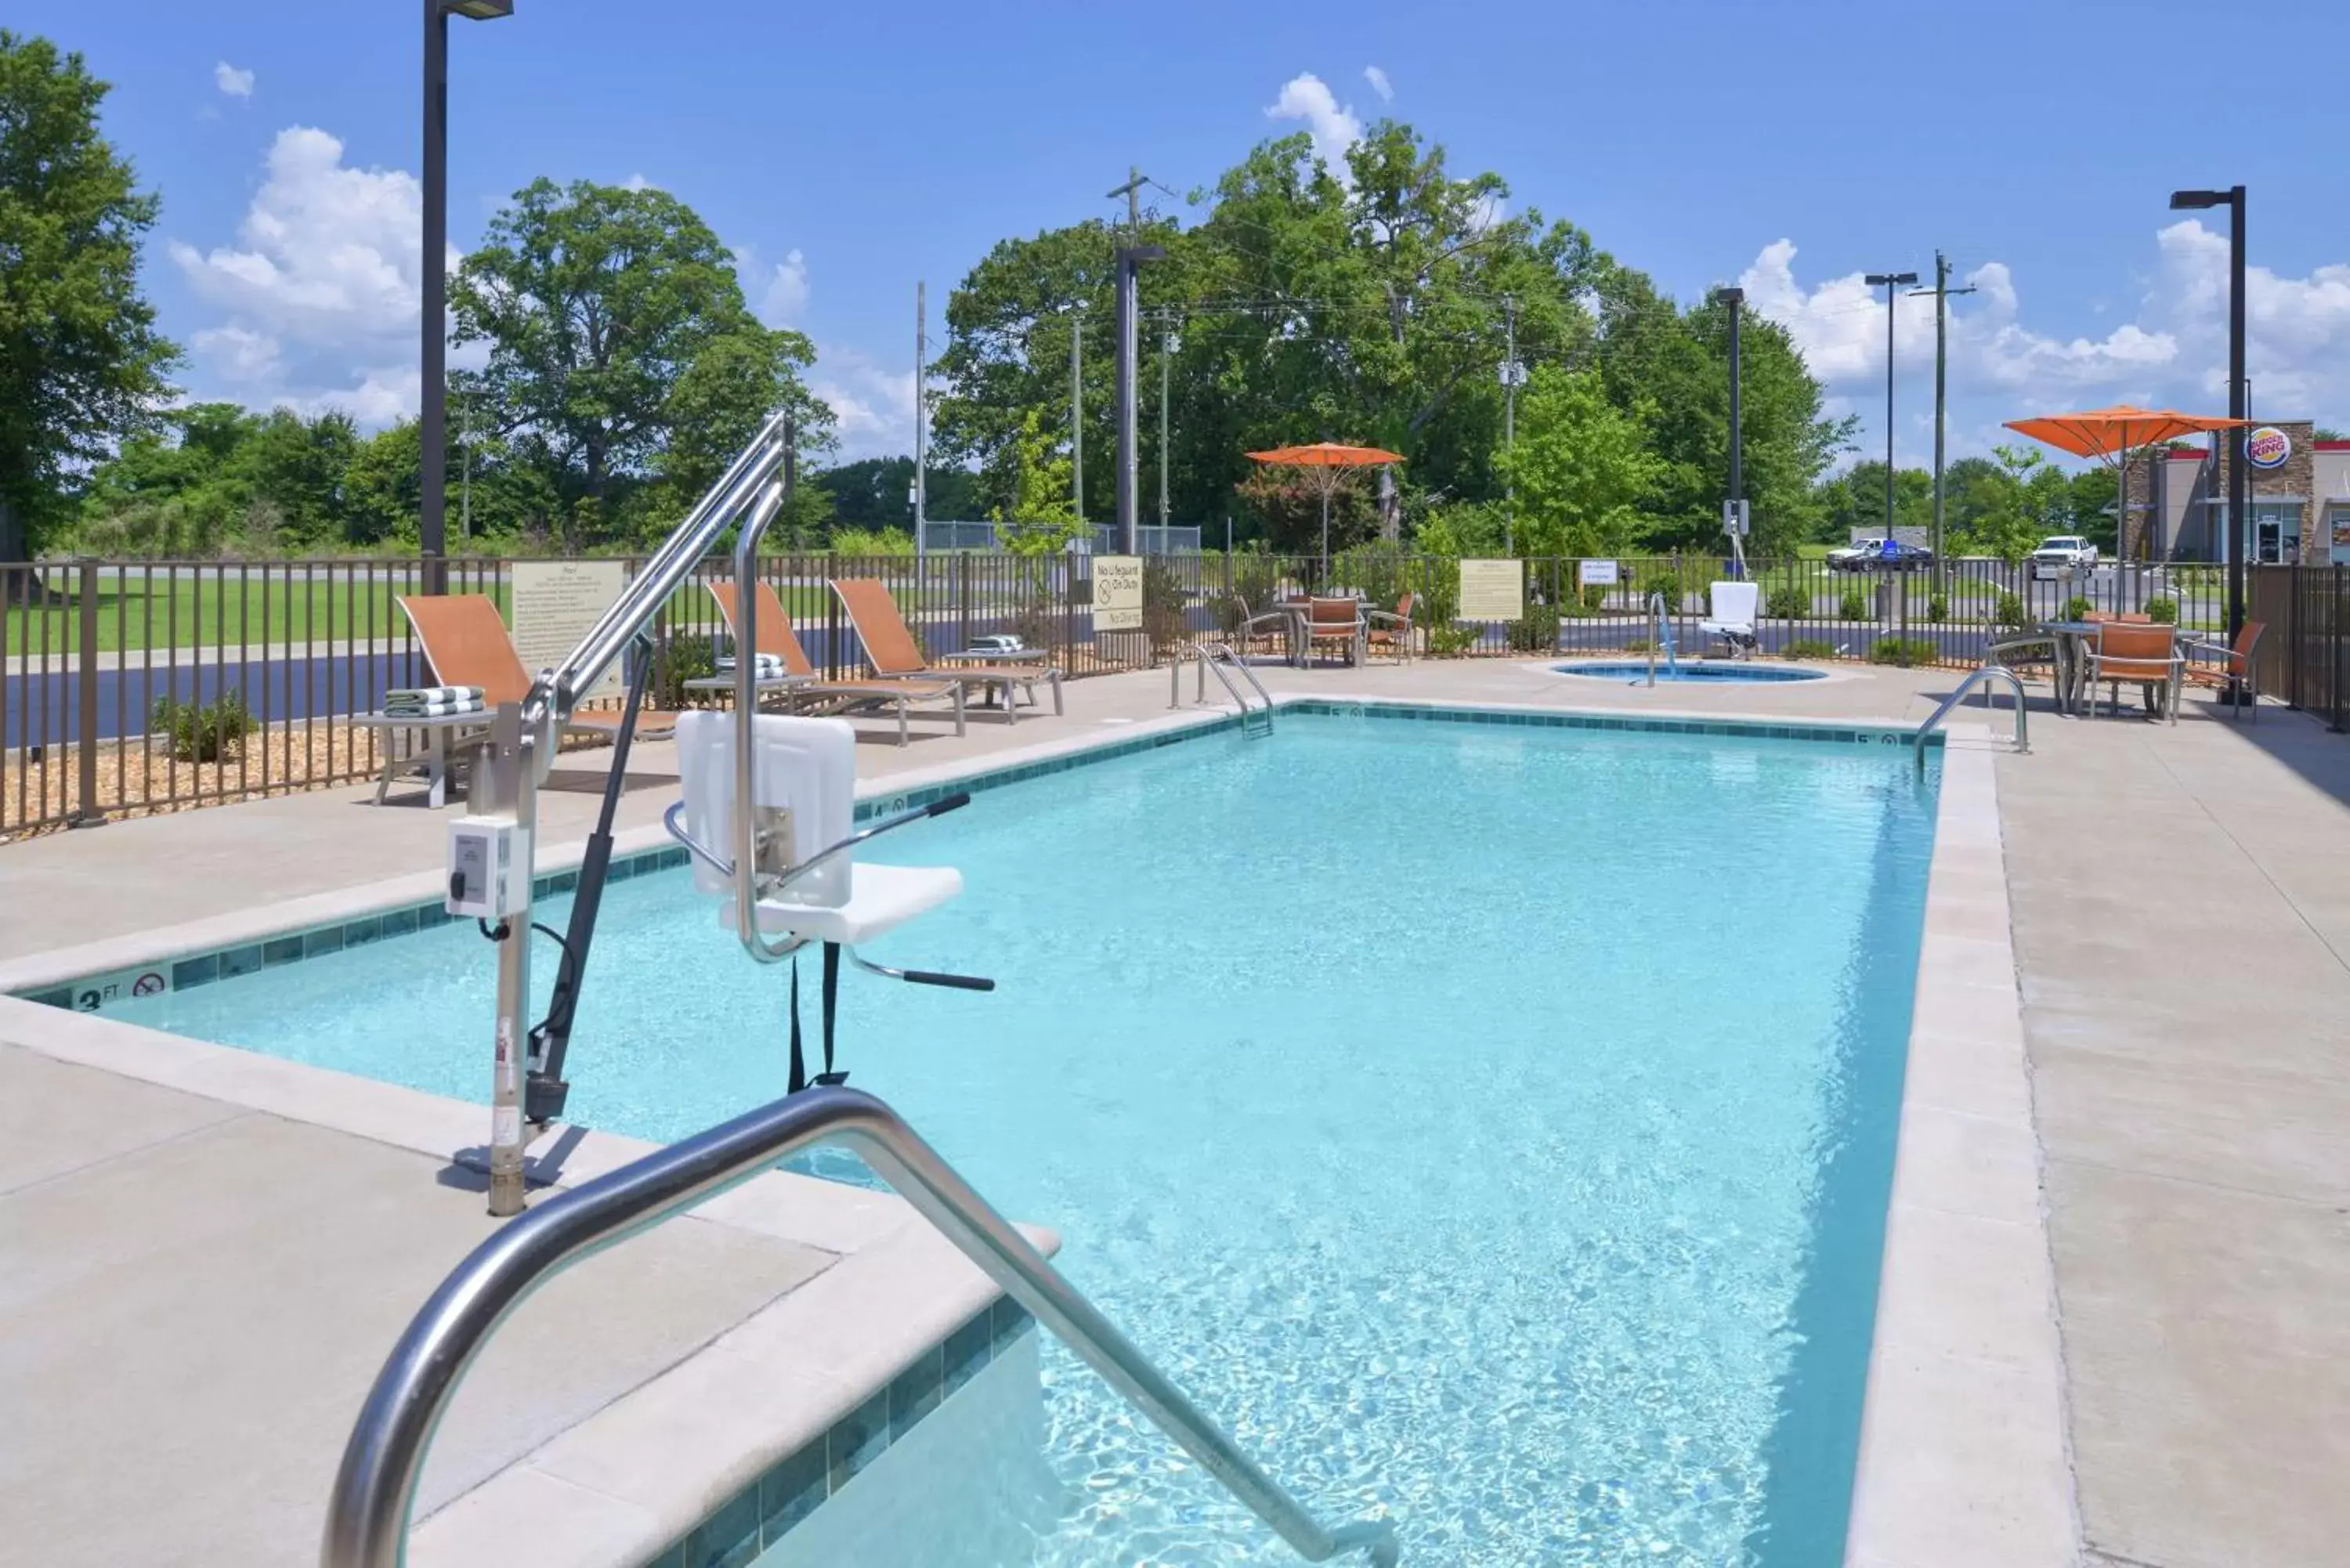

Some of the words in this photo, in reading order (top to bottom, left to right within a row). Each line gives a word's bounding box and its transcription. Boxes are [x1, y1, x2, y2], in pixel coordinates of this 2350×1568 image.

[2251, 441, 2285, 457] KING
[1098, 564, 1108, 576] No
[1109, 564, 1138, 578] Lifeguard
[103, 984, 119, 999] FT
